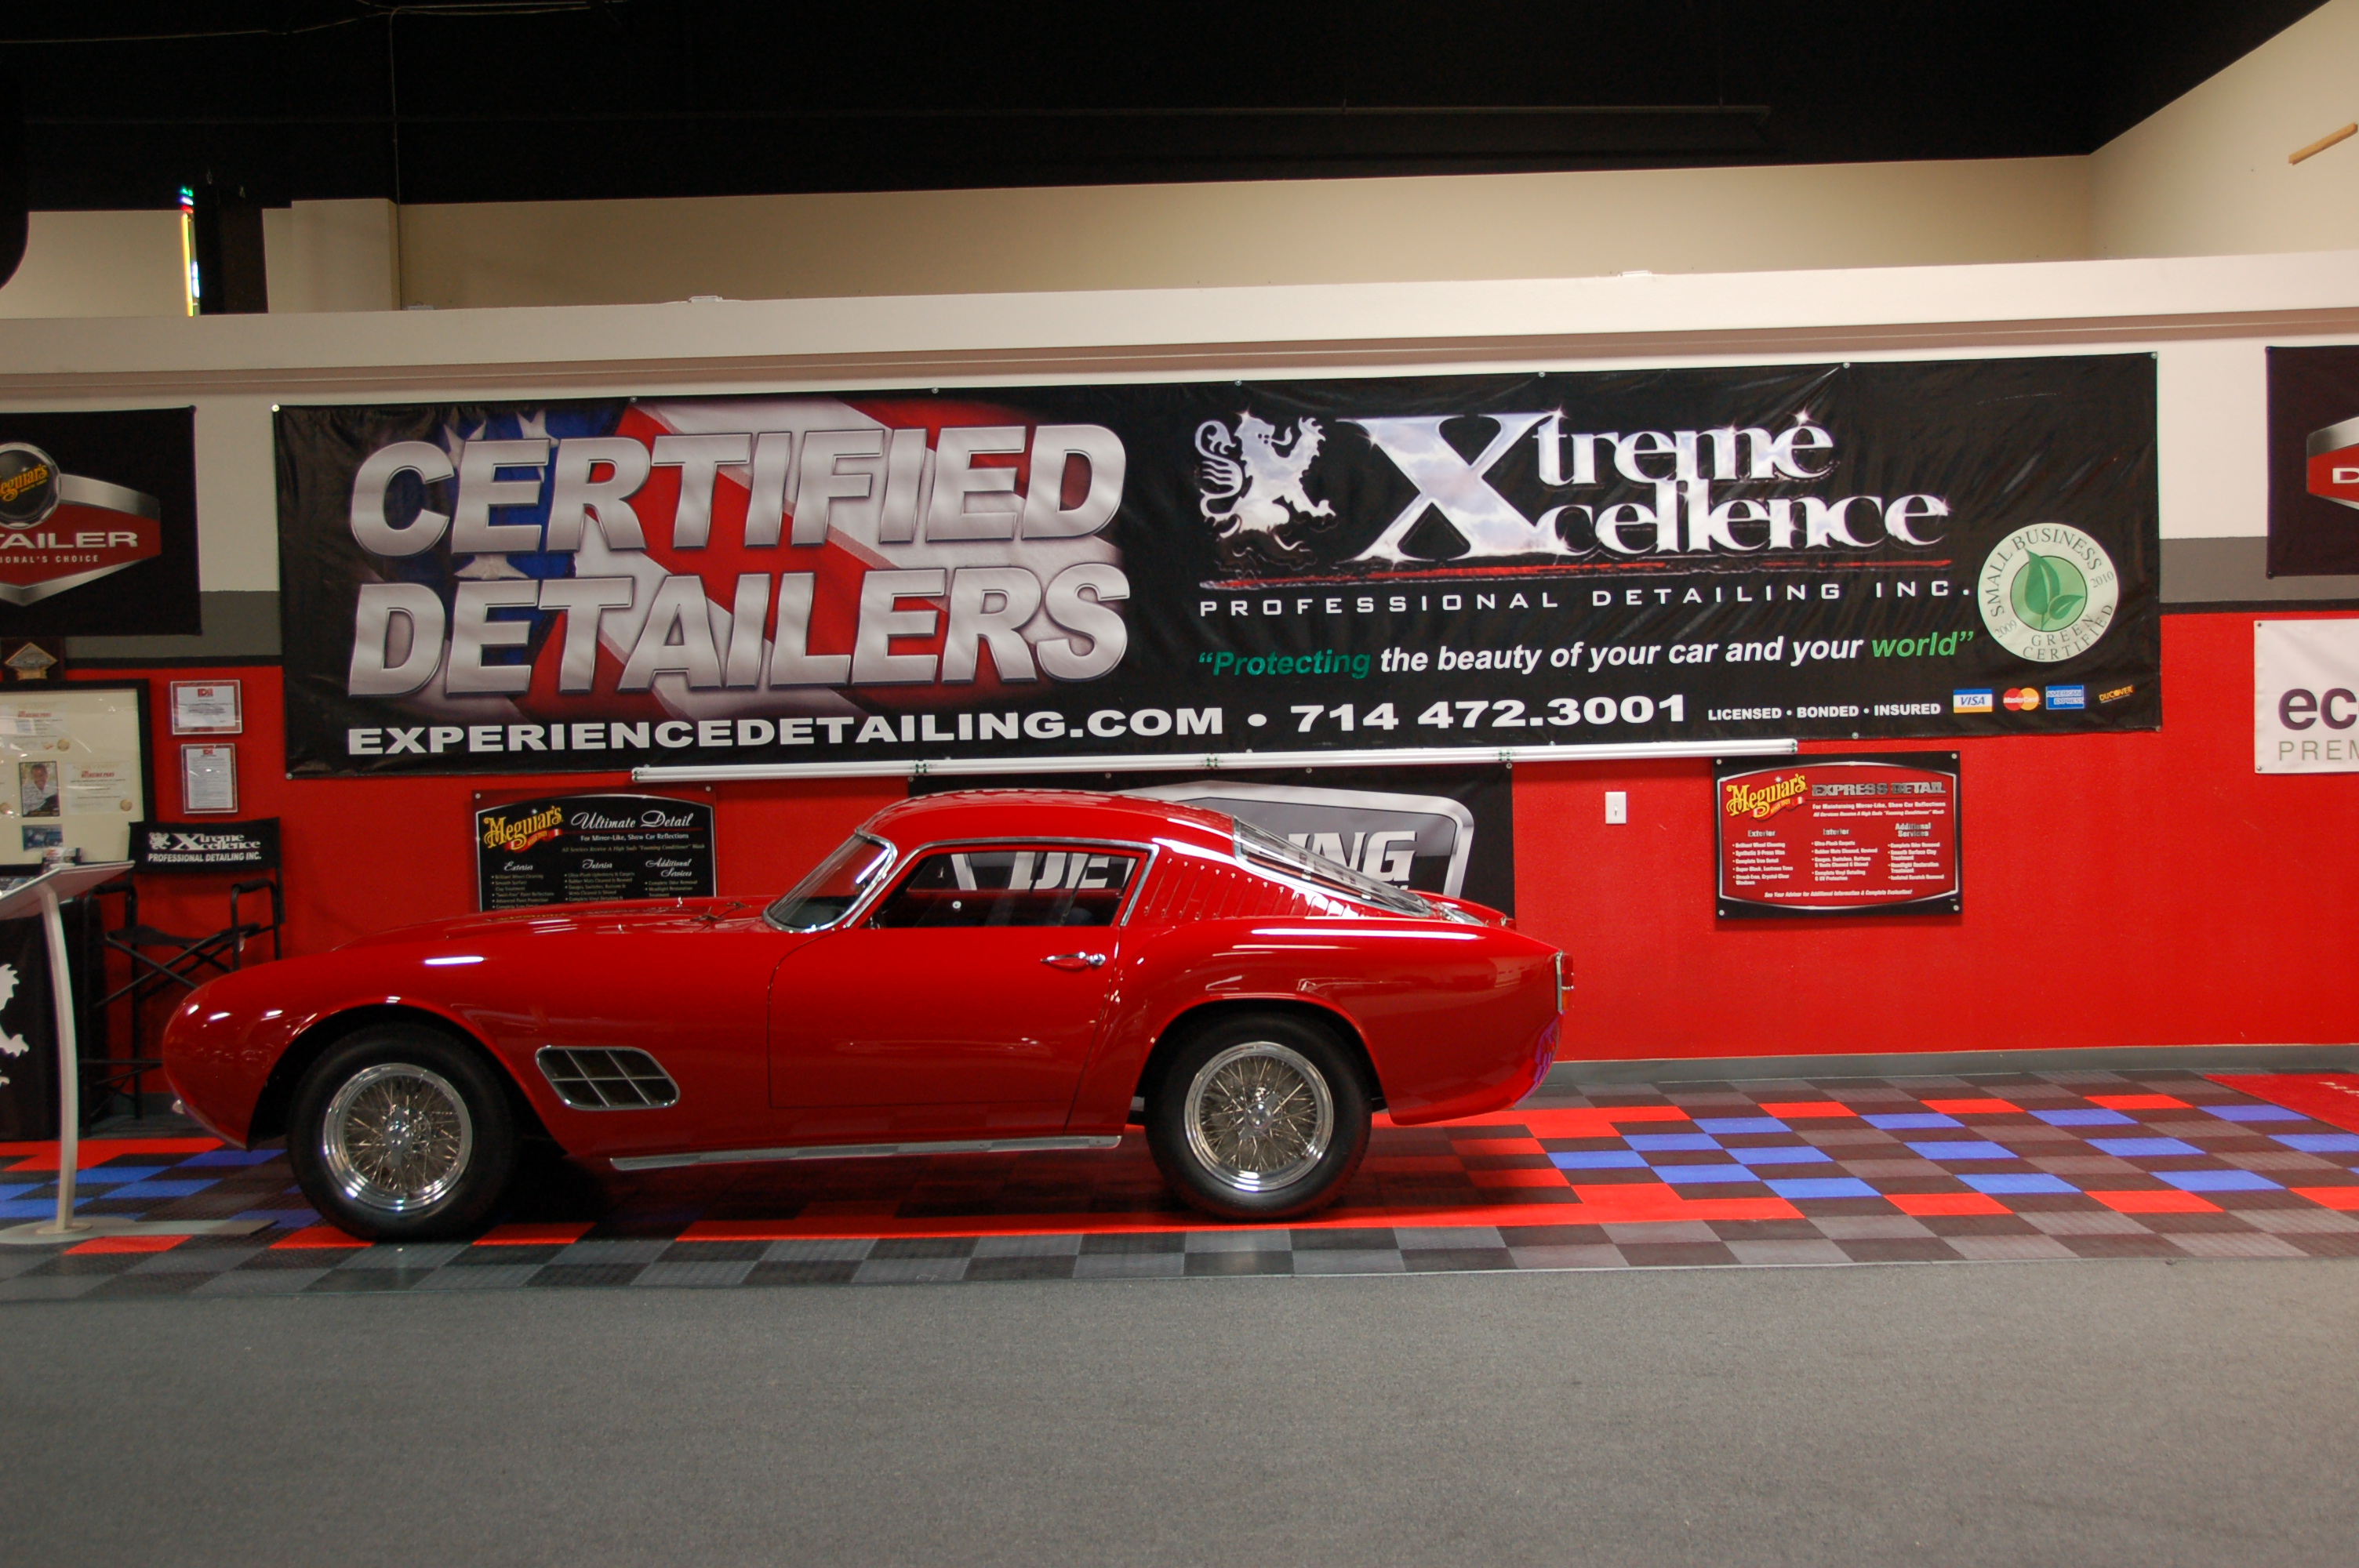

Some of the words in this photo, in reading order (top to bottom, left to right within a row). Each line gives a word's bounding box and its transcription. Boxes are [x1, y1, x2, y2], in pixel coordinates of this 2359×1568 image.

[0, 463, 48, 502] eguiar's
[351, 424, 1127, 557] CERTIFIED
[0, 532, 138, 549] AILER
[1985, 551, 2013, 618] SMALL
[2012, 528, 2102, 571] BUSINESS
[2089, 571, 2115, 589] 2010
[1200, 591, 1558, 616] PROFESSIONAL
[1592, 583, 1840, 607] DETAILING
[1876, 581, 1969, 598] INC.
[348, 563, 1130, 697] DETAILERS
[1994, 619, 2017, 639] 2009
[2023, 604, 2113, 661] CERTIFIED
[2031, 614, 2095, 647] GREEN
[1380, 648, 1428, 672] the
[1438, 644, 1542, 674] beauty
[1550, 641, 1584, 667] of
[1587, 648, 1660, 673] your
[1668, 644, 1717, 665] car
[1725, 636, 1784, 662] and
[1790, 637, 1863, 666] your
[1708, 707, 1782, 720] LICENSED
[1796, 705, 1859, 719] BONDED
[1874, 703, 1941, 717] INSURED
[1961, 695, 1986, 706] VISA
[348, 707, 1223, 756] EXPERIENCEDETAILING.COM
[1291, 702, 1399, 732] 714
[1418, 695, 1685, 729] 472.3001
[1726, 774, 1805, 818] Meguiar's
[1812, 783, 1888, 796] EXPRESS
[1892, 782, 1946, 793] DETAIL
[484, 805, 563, 850] Meguiar's
[571, 812, 635, 829] Ultimate
[641, 810, 693, 827] Detail
[148, 852, 204, 862] PROFESSIONAL
[205, 851, 245, 862] DETAILING
[245, 851, 262, 860] INC.
